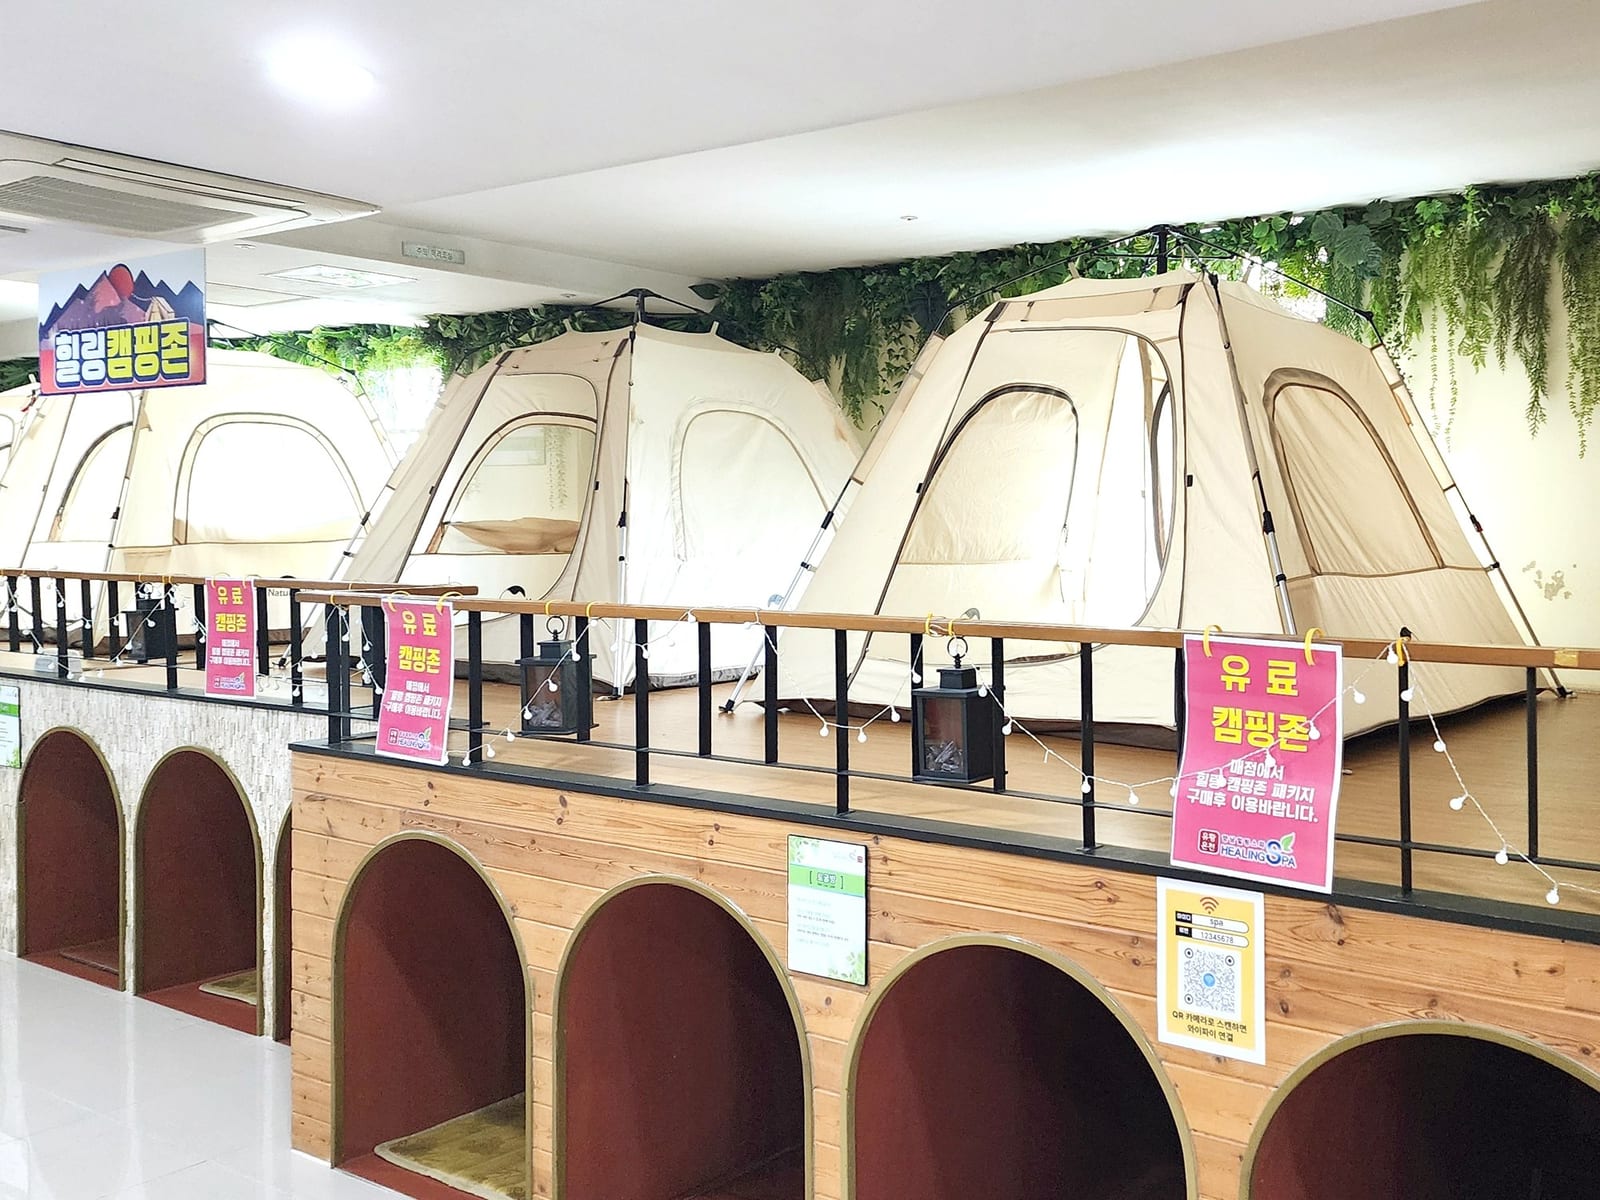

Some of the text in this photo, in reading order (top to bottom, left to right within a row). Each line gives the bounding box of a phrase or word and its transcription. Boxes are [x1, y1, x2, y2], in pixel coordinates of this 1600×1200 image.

[215, 613, 247, 632] 캠핑존
[398, 645, 441, 674] 캠핑존
[1212, 706, 1310, 752] 캠핑존
[1229, 759, 1284, 781] 매점에서
[1226, 778, 1268, 798] 캠핑존
[1271, 784, 1315, 804] 패키지
[1186, 788, 1319, 823] 구매후 이용바랍니다.
[1210, 918, 1224, 929] spa
[1200, 931, 1234, 944] 12345678
[1172, 1011, 1184, 1020] QR
[1186, 1013, 1214, 1028] 카메라로
[1187, 1024, 1234, 1043] 와이파이 연결
